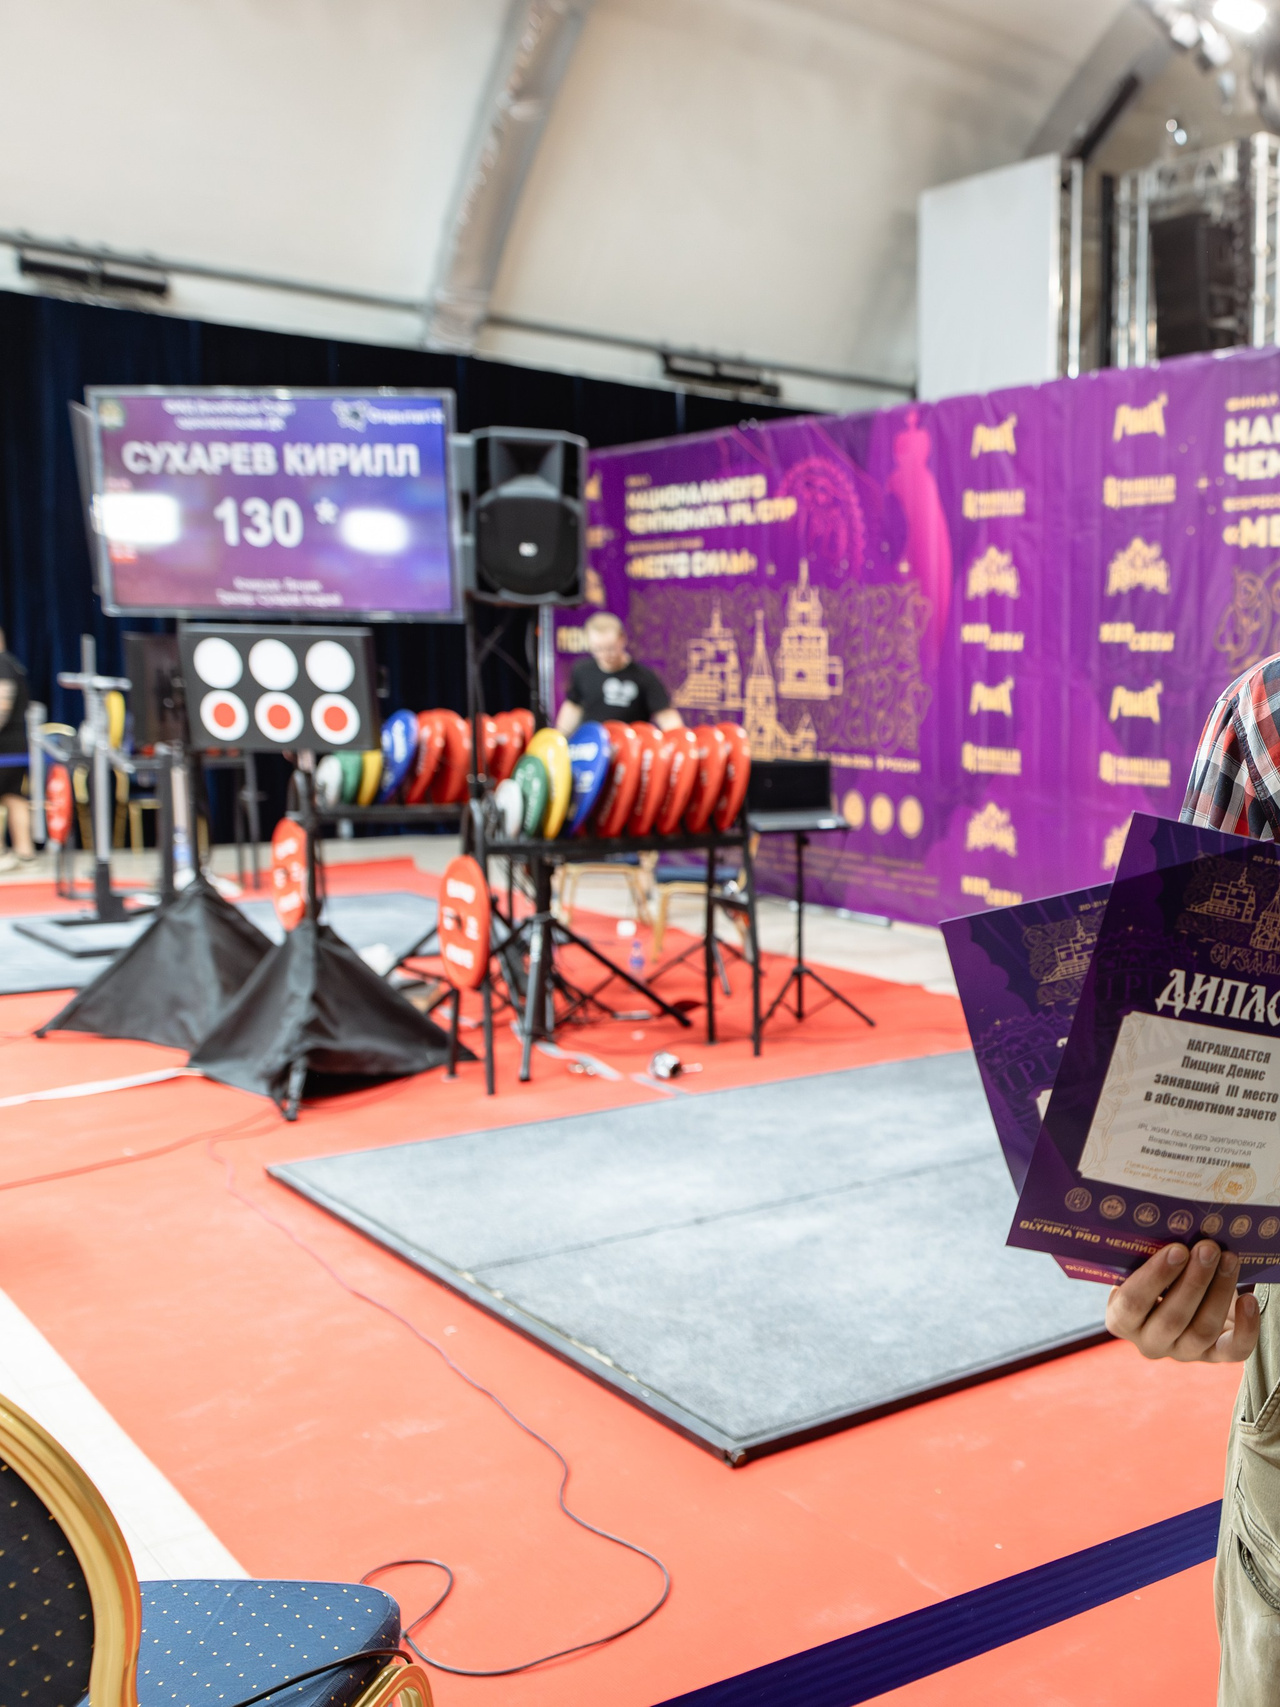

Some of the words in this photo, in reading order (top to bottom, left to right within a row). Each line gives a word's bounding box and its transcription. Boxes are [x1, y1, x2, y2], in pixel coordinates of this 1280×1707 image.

[122, 441, 279, 476] СУХАРЕВ
[283, 443, 421, 477] КИРИЛЛ
[214, 496, 304, 548] 130
[1186, 1038, 1272, 1064] НАГРАЖДАЕТСЯ
[1181, 1055, 1225, 1075] Пищик
[1225, 1064, 1266, 1082] Денис
[1153, 1073, 1220, 1095] занявший
[1225, 1083, 1240, 1098] III
[1242, 1088, 1280, 1104] место
[1144, 1091, 1152, 1102] в
[1154, 1092, 1235, 1117] абсолютном
[1236, 1106, 1277, 1122] зачете
[1150, 1125, 1170, 1135] ЖИМ
[1170, 1129, 1192, 1139] ЛЕЖА
[1188, 1143, 1211, 1153] группа
[1020, 1220, 1072, 1238] OLYMPIA
[1075, 1231, 1101, 1243] PRO
[1105, 1237, 1157, 1255] ЧЕМПИО
